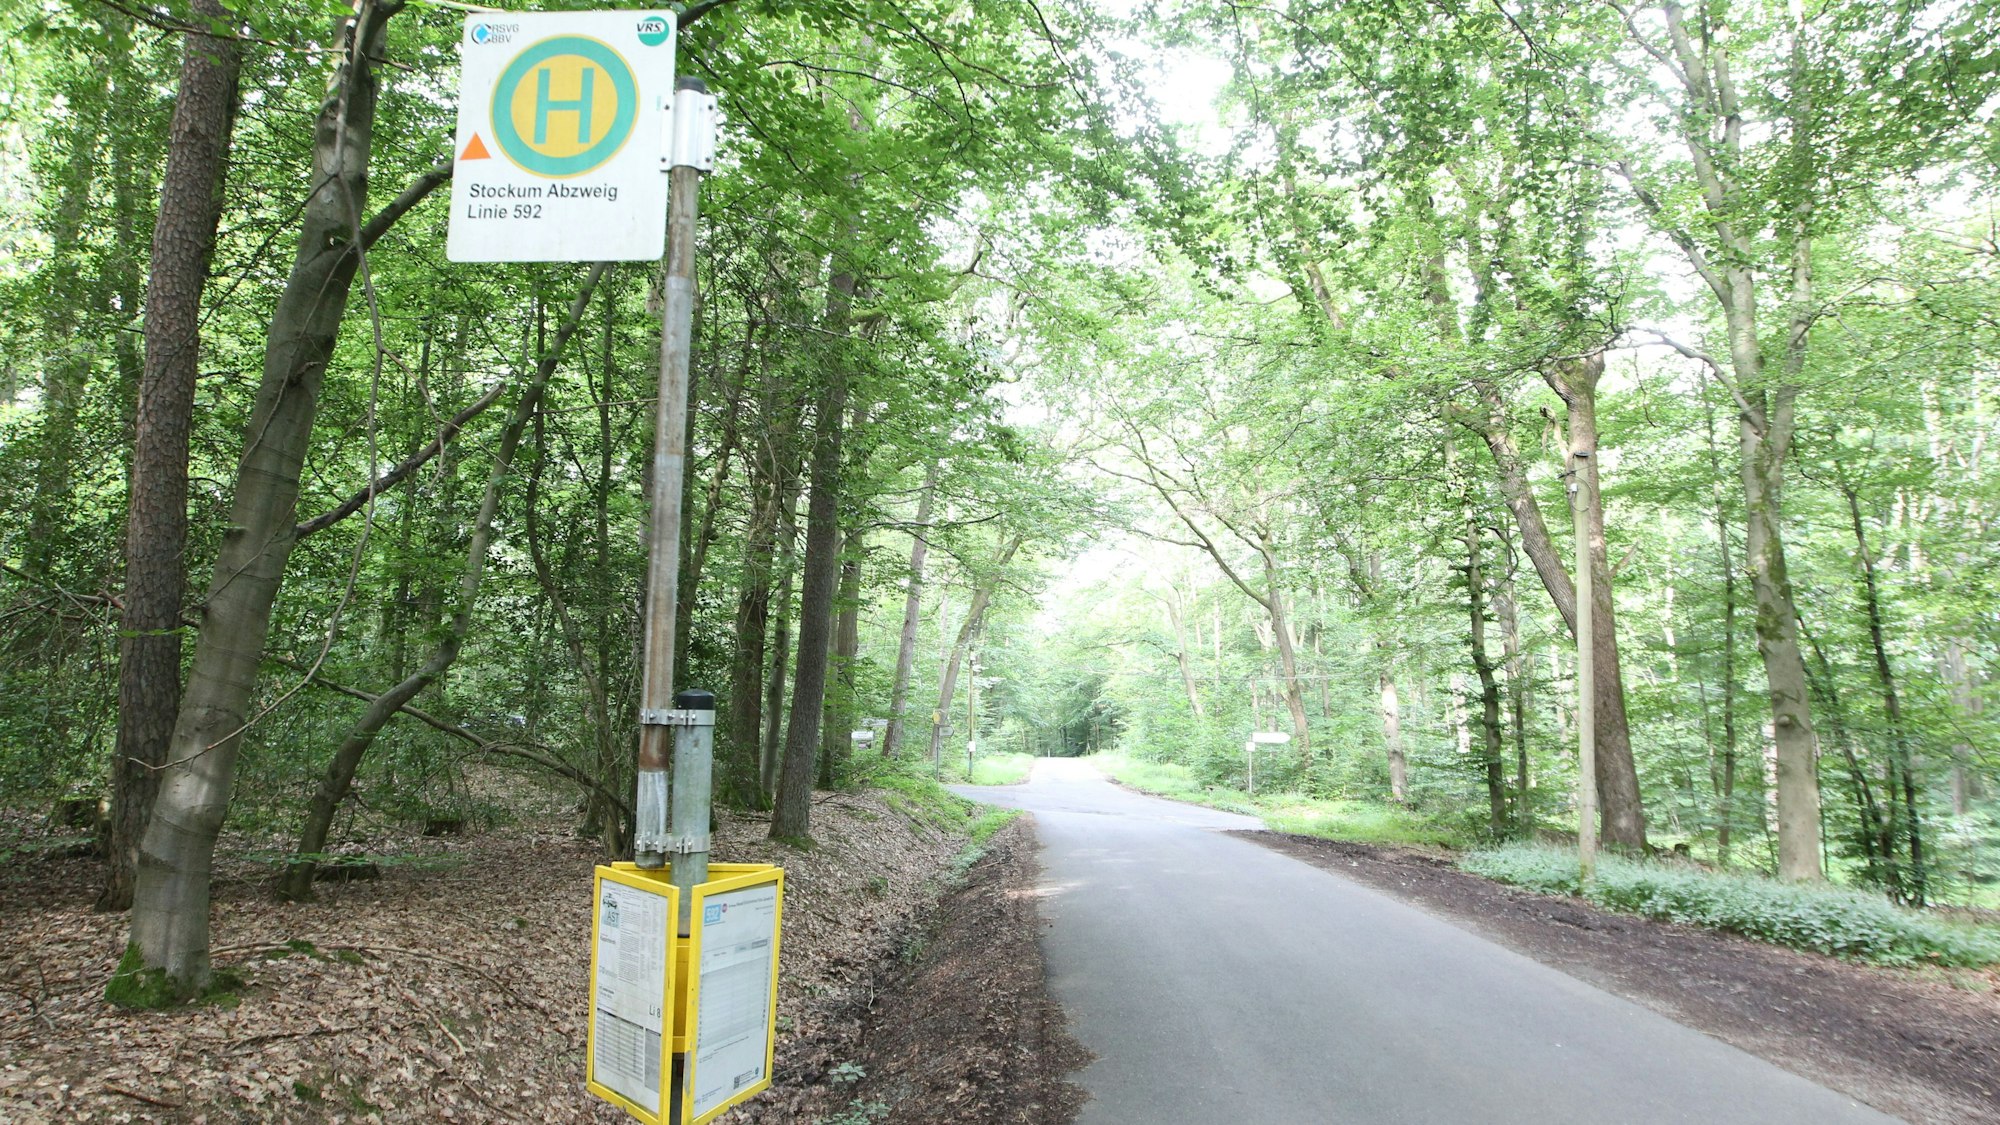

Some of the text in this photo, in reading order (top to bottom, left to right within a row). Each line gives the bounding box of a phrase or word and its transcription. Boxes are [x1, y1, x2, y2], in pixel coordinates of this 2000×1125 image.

[491, 23, 519, 33] RSVG
[636, 22, 662, 32] VRS
[491, 34, 512, 43] BBV
[533, 67, 595, 145] H
[469, 183, 618, 202] Stockum Abzweig
[468, 204, 542, 219] Linie 592
[606, 911, 620, 923] AST
